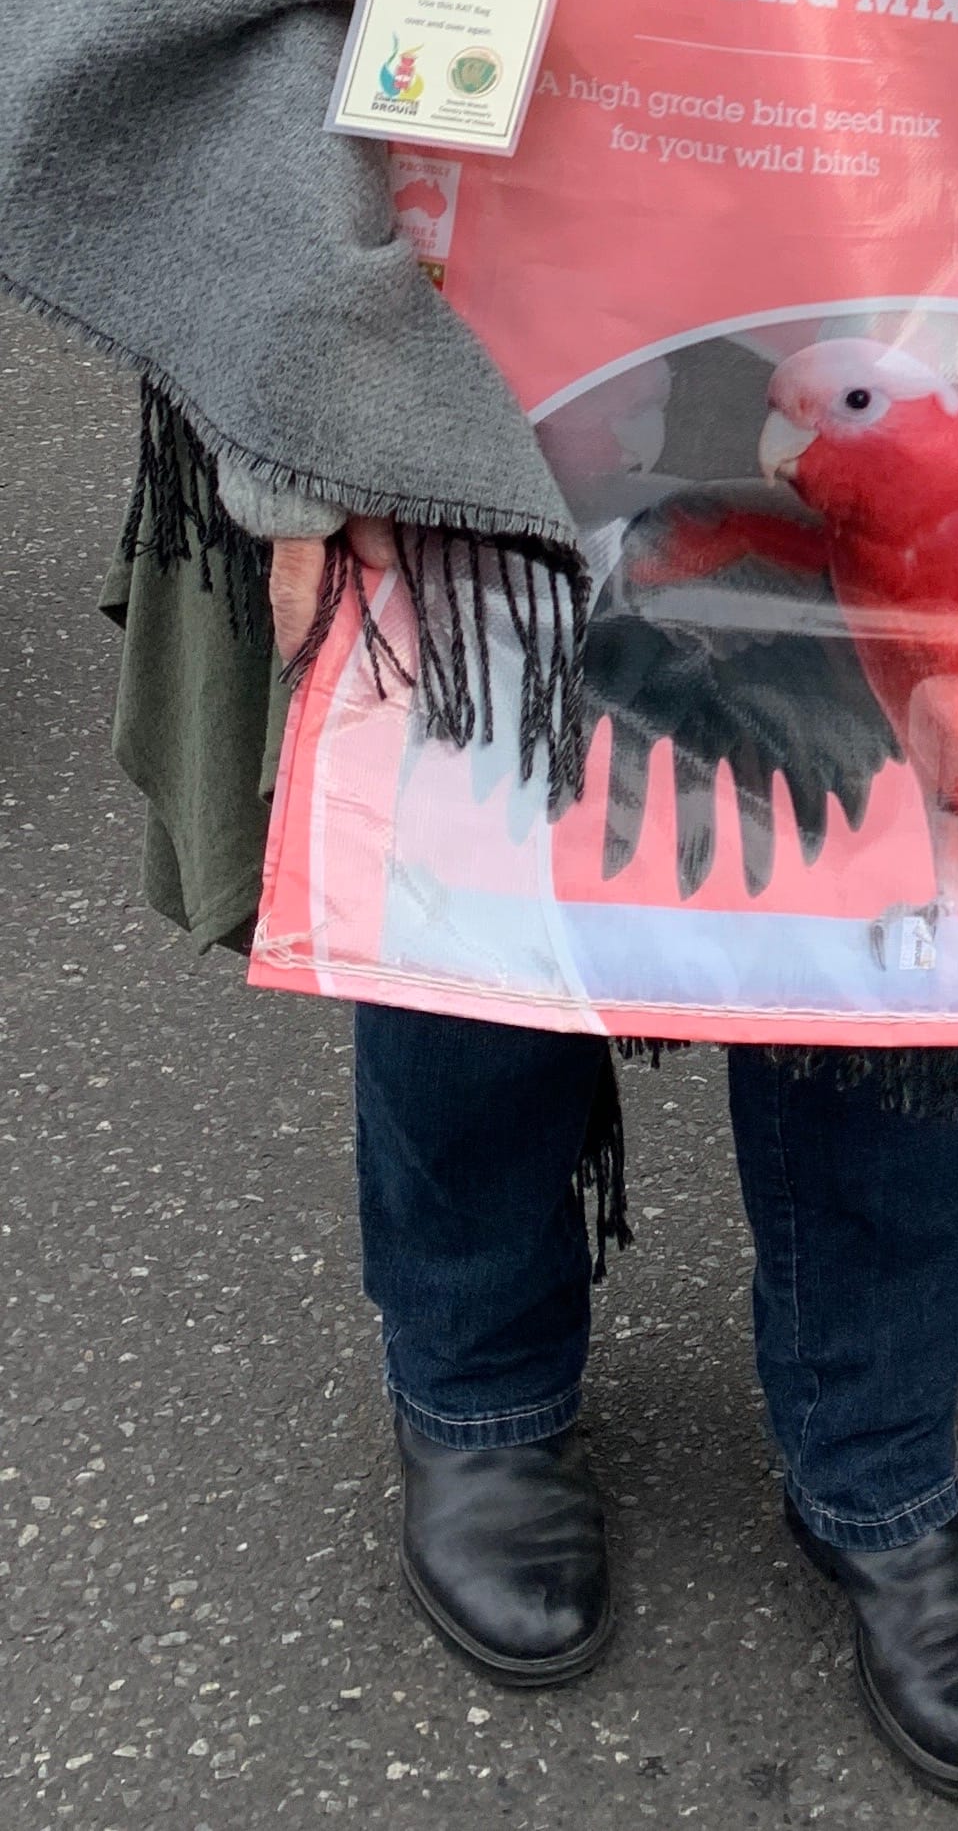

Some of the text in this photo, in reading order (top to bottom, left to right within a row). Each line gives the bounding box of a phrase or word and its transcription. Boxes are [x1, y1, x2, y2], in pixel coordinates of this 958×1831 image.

[536, 71, 943, 138] A high grade bird seed mix
[610, 123, 880, 177] for your wild birds
